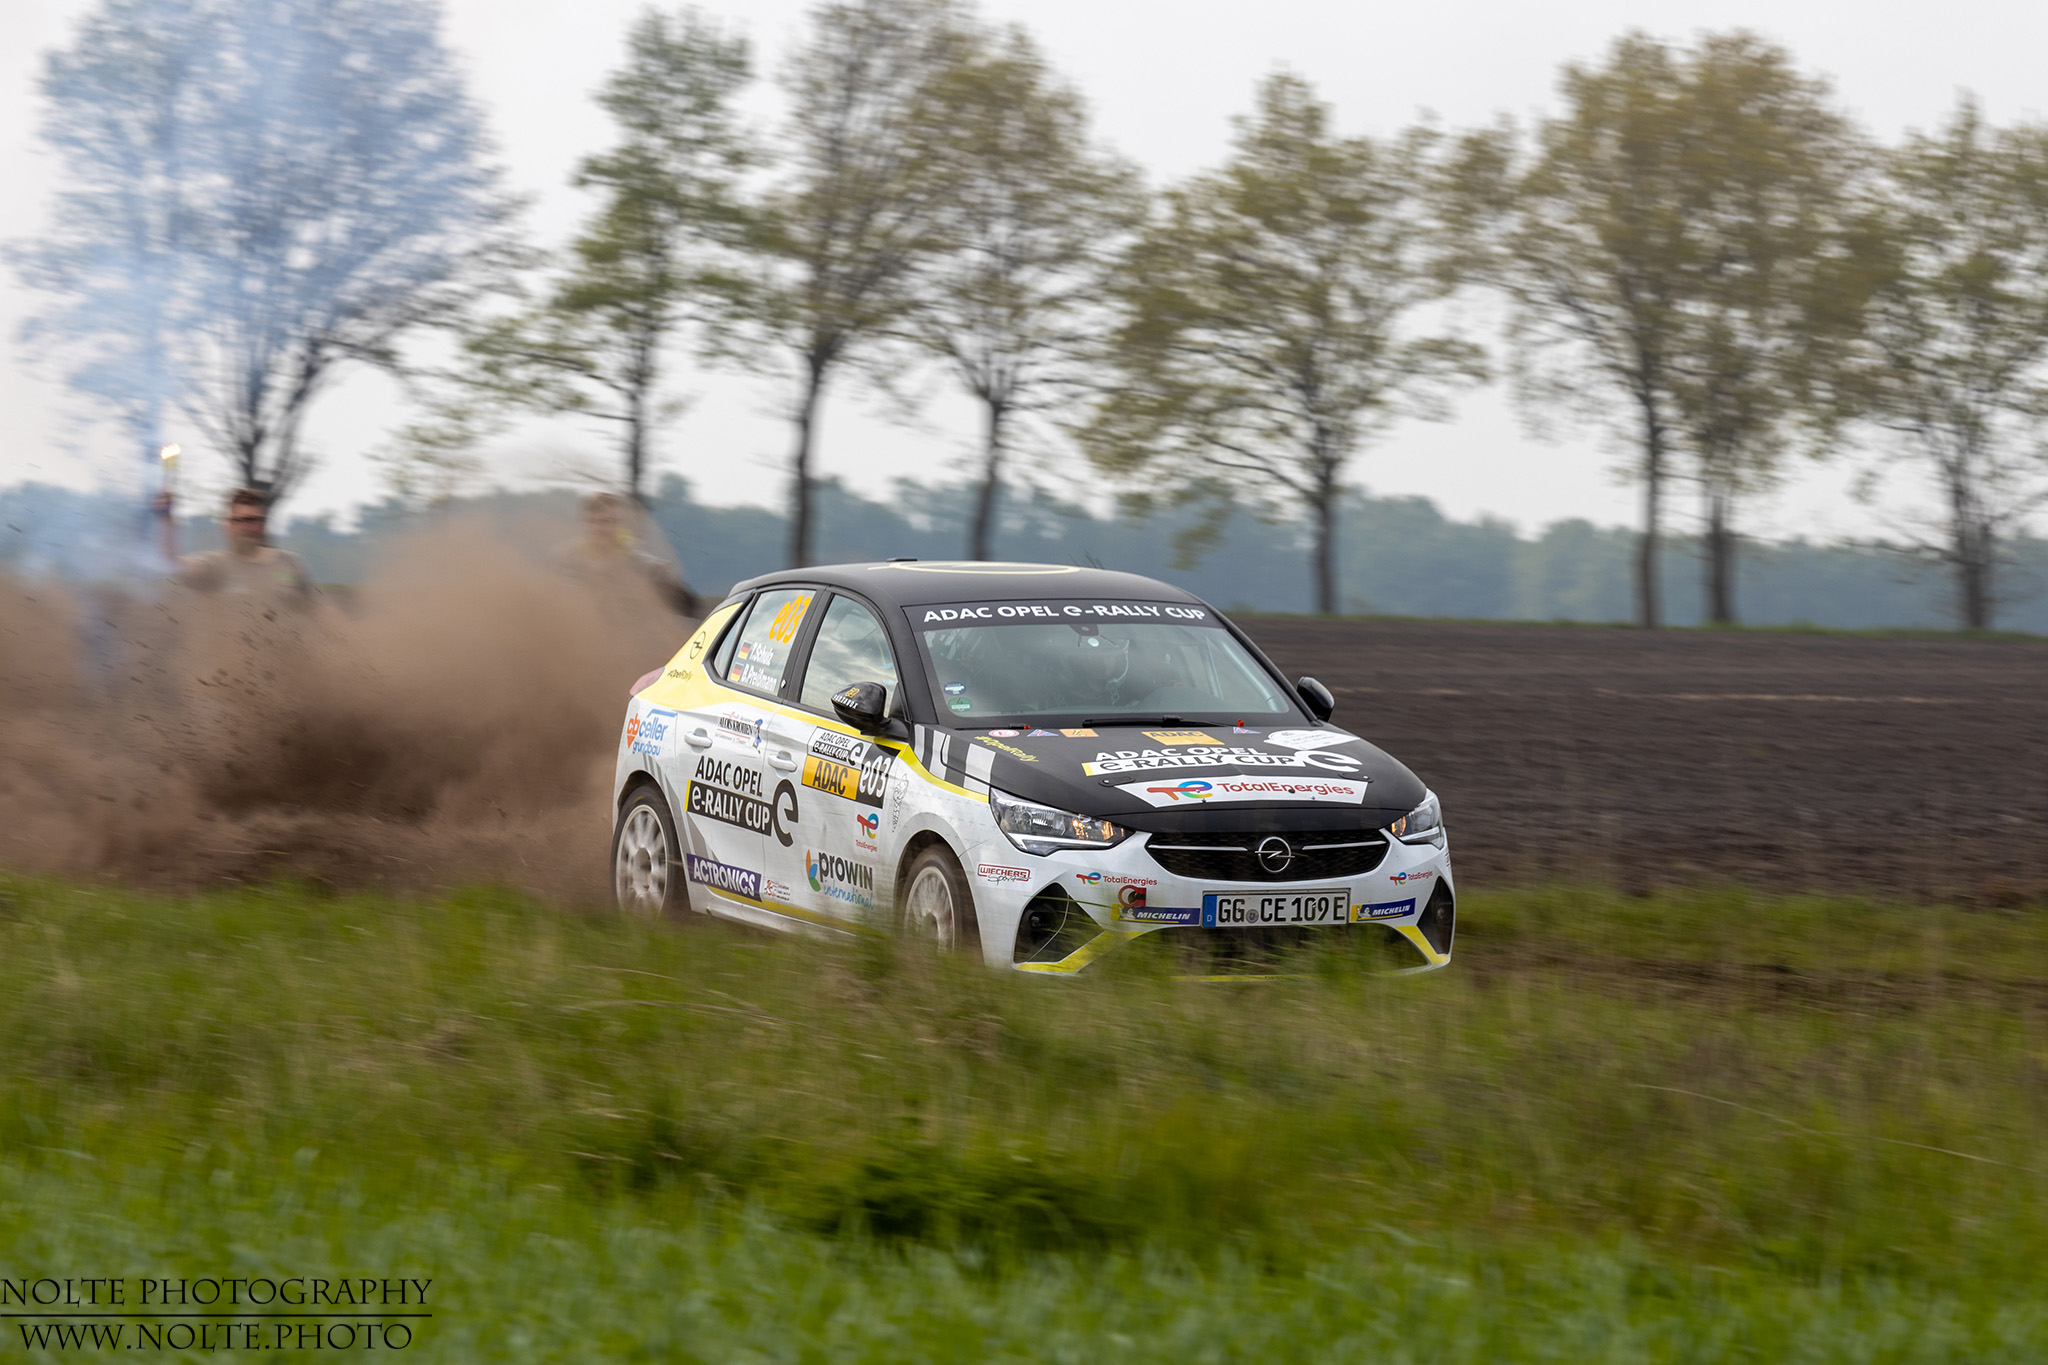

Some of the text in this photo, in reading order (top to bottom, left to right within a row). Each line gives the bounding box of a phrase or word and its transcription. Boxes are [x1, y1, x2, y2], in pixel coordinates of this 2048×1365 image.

[768, 595, 812, 644] e03
[923, 605, 1206, 622] ADAC OPEL e-RALLY CUP
[638, 717, 669, 742] celler
[632, 740, 661, 756] grundbau
[819, 732, 851, 748] ADAC OPEL
[1095, 747, 1268, 761] ADAC OPEL
[1100, 755, 1295, 770] e-RALLY CUP
[695, 755, 762, 797] ADAC OPEL
[813, 760, 848, 796] ADAC
[859, 755, 892, 798] e03
[1216, 782, 1354, 796] TotalEnergies
[692, 785, 770, 831] e-RALLY CUP
[693, 858, 756, 897] ACTRONICS
[980, 866, 1028, 878] WIECHERS
[1103, 875, 1158, 886] TotalEnergies
[1136, 911, 1191, 920] MICHELIN
[1218, 898, 1245, 923] GG
[1260, 897, 1286, 922] CE
[1371, 904, 1411, 916] MICHELIN
[1206, 914, 1213, 923] D
